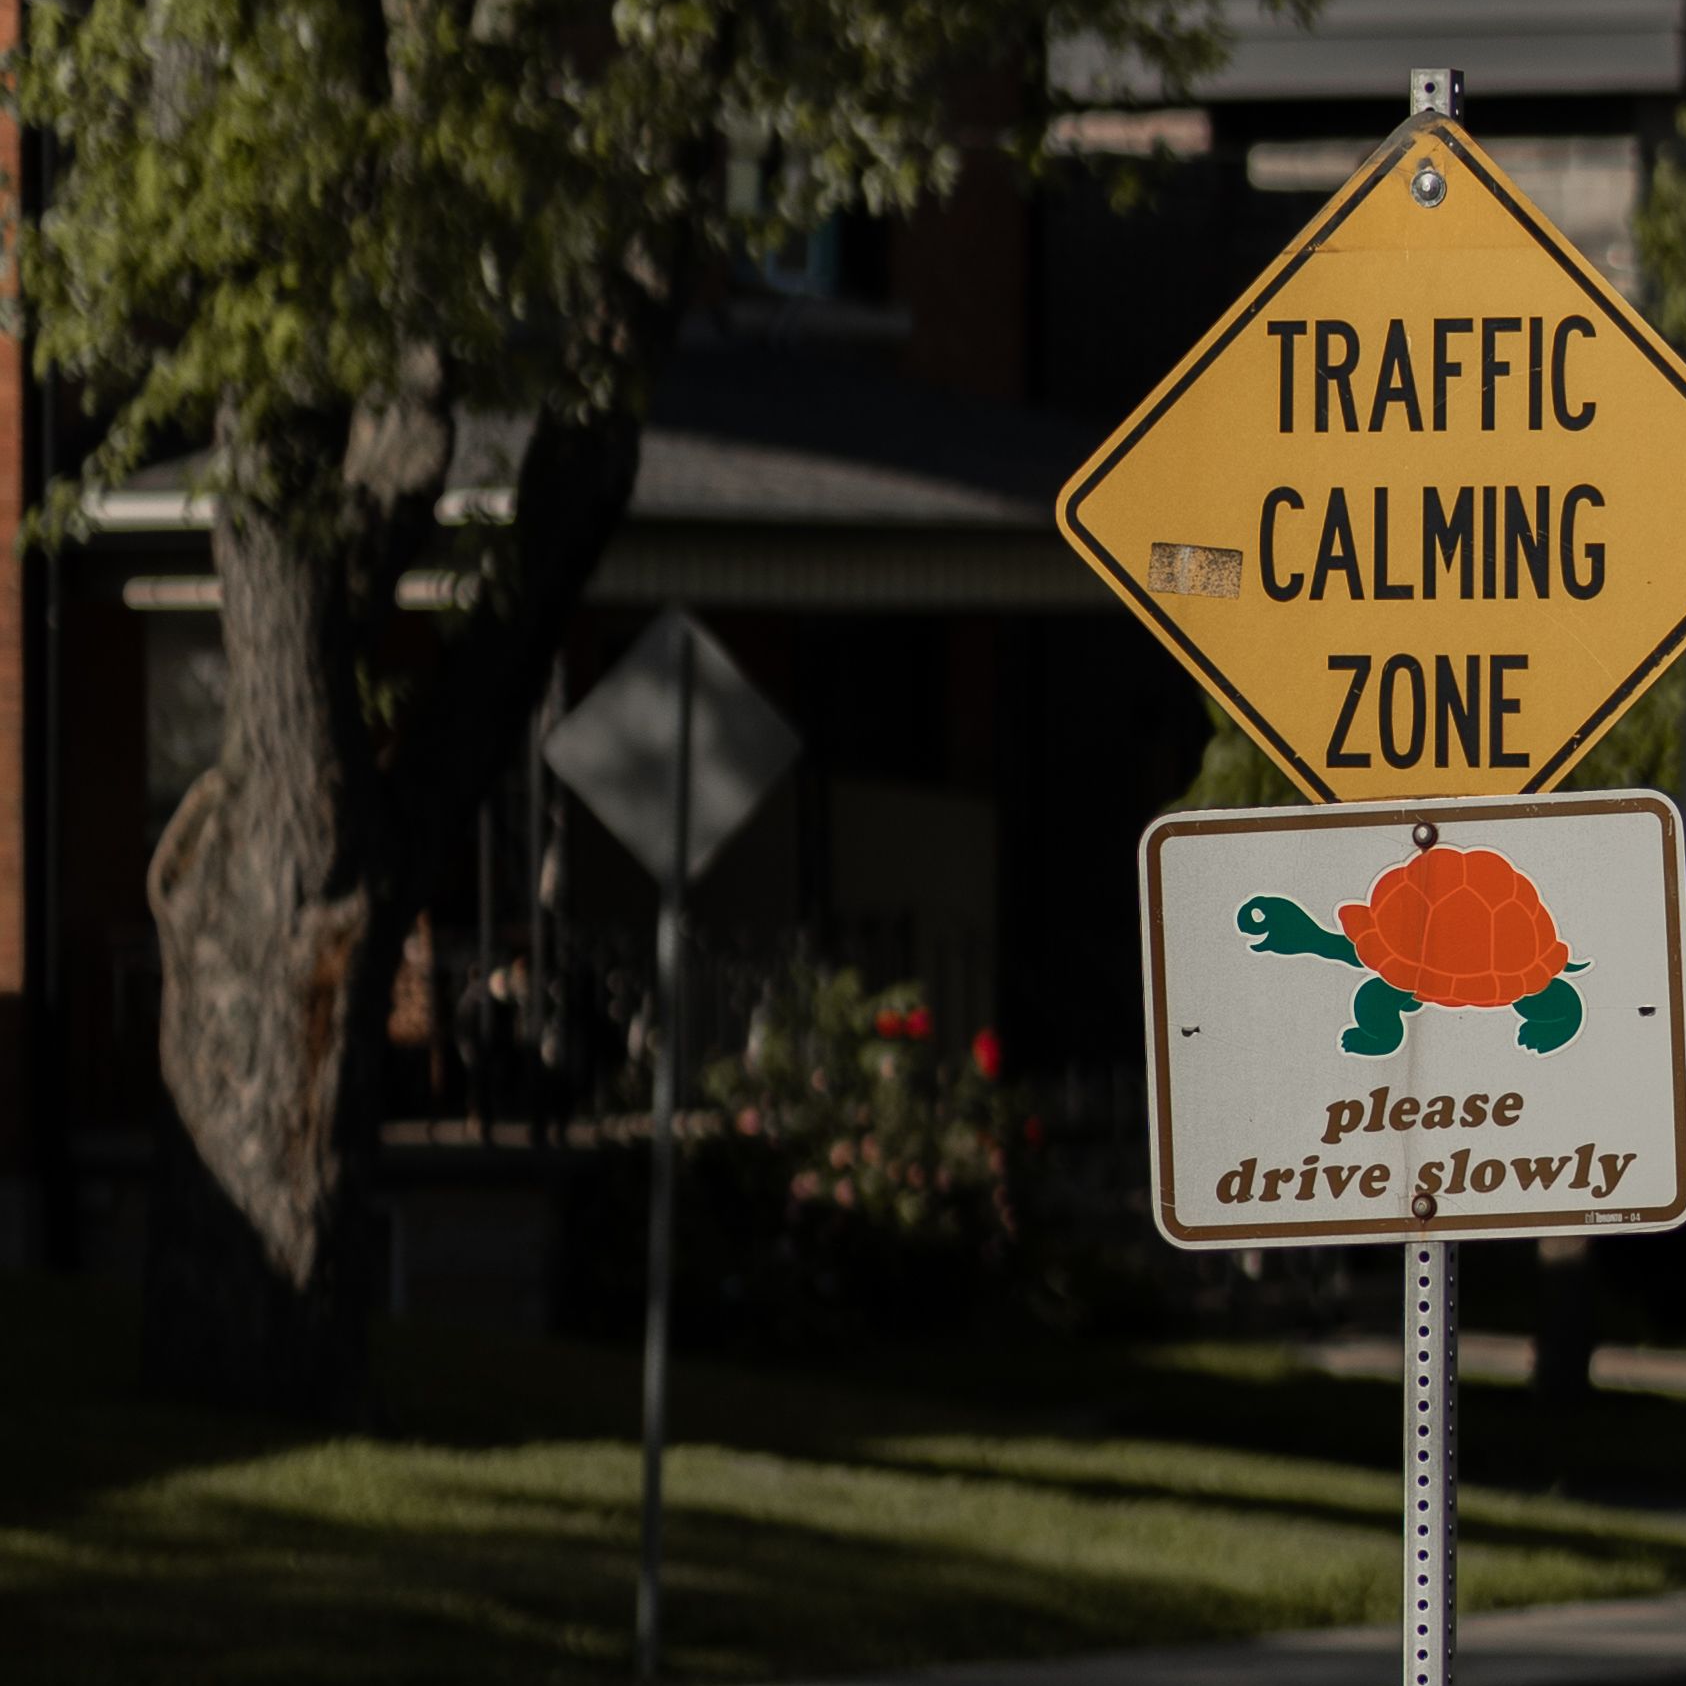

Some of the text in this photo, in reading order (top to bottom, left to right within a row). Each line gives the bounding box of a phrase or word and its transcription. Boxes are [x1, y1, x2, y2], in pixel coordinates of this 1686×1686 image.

[1266, 315, 1597, 433] TRAFFIC
[1259, 484, 1606, 602] CALMING
[1326, 653, 1530, 770] ZONE
[1215, 1143, 1637, 1204] drive slowly
[1320, 1086, 1524, 1145] please
